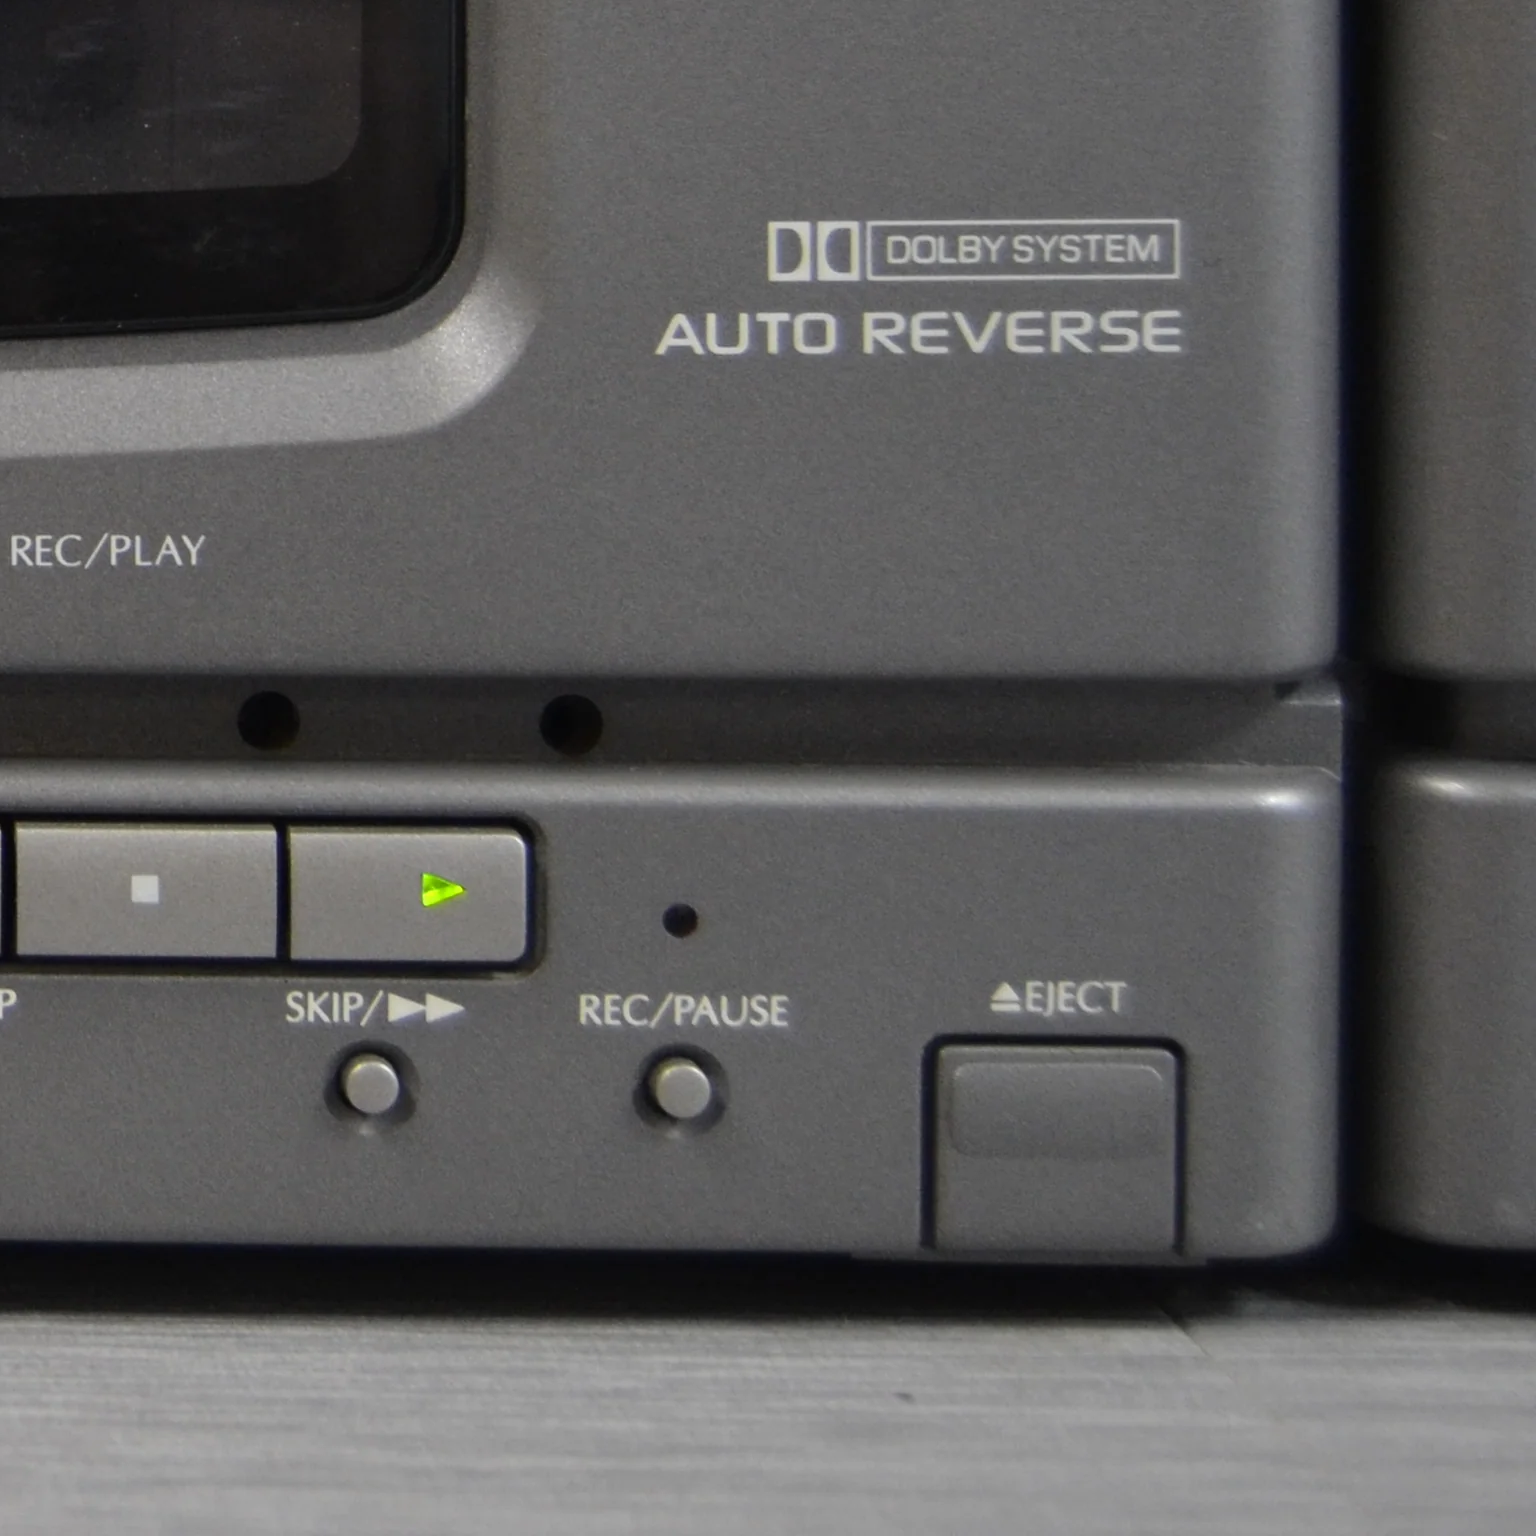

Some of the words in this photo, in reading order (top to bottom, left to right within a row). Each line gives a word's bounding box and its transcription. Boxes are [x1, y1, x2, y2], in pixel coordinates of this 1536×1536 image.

[886, 234, 1006, 265] DOLBY
[1012, 233, 1161, 264] SYSTEM
[654, 311, 837, 355] AUTO
[862, 309, 1183, 354] REVERSE
[10, 532, 207, 571] REC/PLAY
[578, 992, 790, 1029] REC/PAUSE
[1025, 980, 1128, 1015] EJECT
